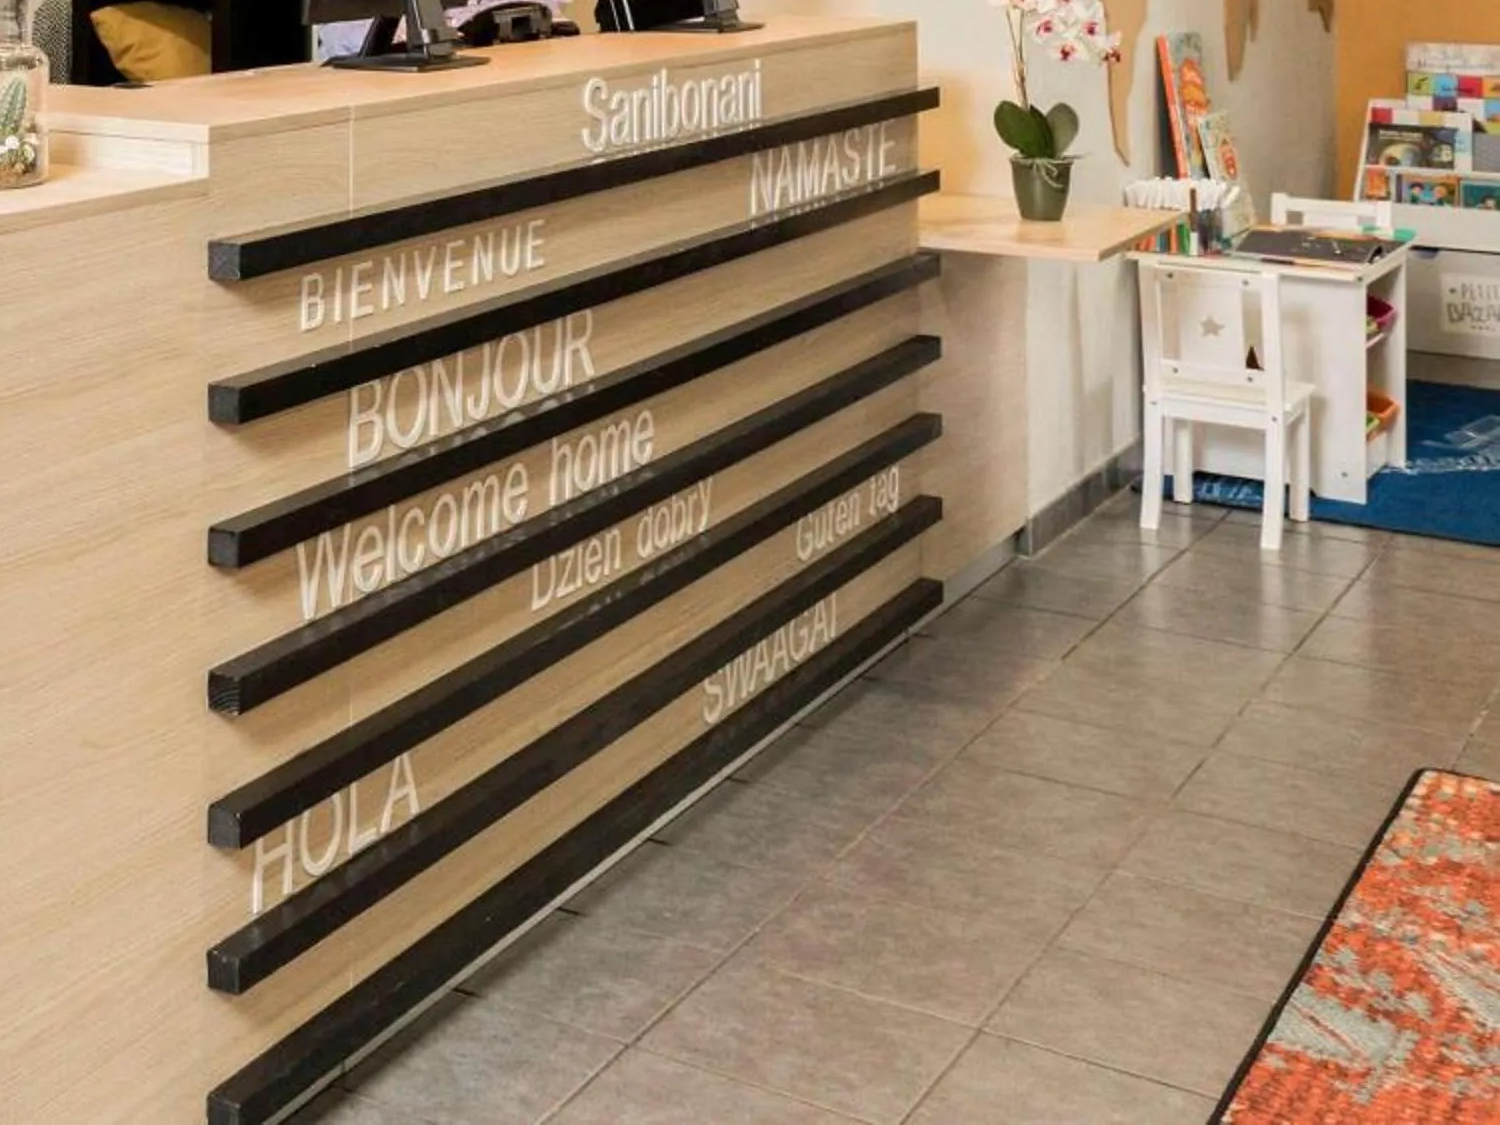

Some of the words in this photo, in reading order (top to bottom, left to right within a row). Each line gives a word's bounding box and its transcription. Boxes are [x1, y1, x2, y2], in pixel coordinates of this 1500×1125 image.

[581, 59, 762, 152] Sanibonani
[300, 219, 545, 333] BIENVENUE
[348, 309, 595, 468] BONJOUR
[297, 462, 529, 621] Welcome
[549, 407, 655, 506] home
[252, 753, 420, 915] HOLA
